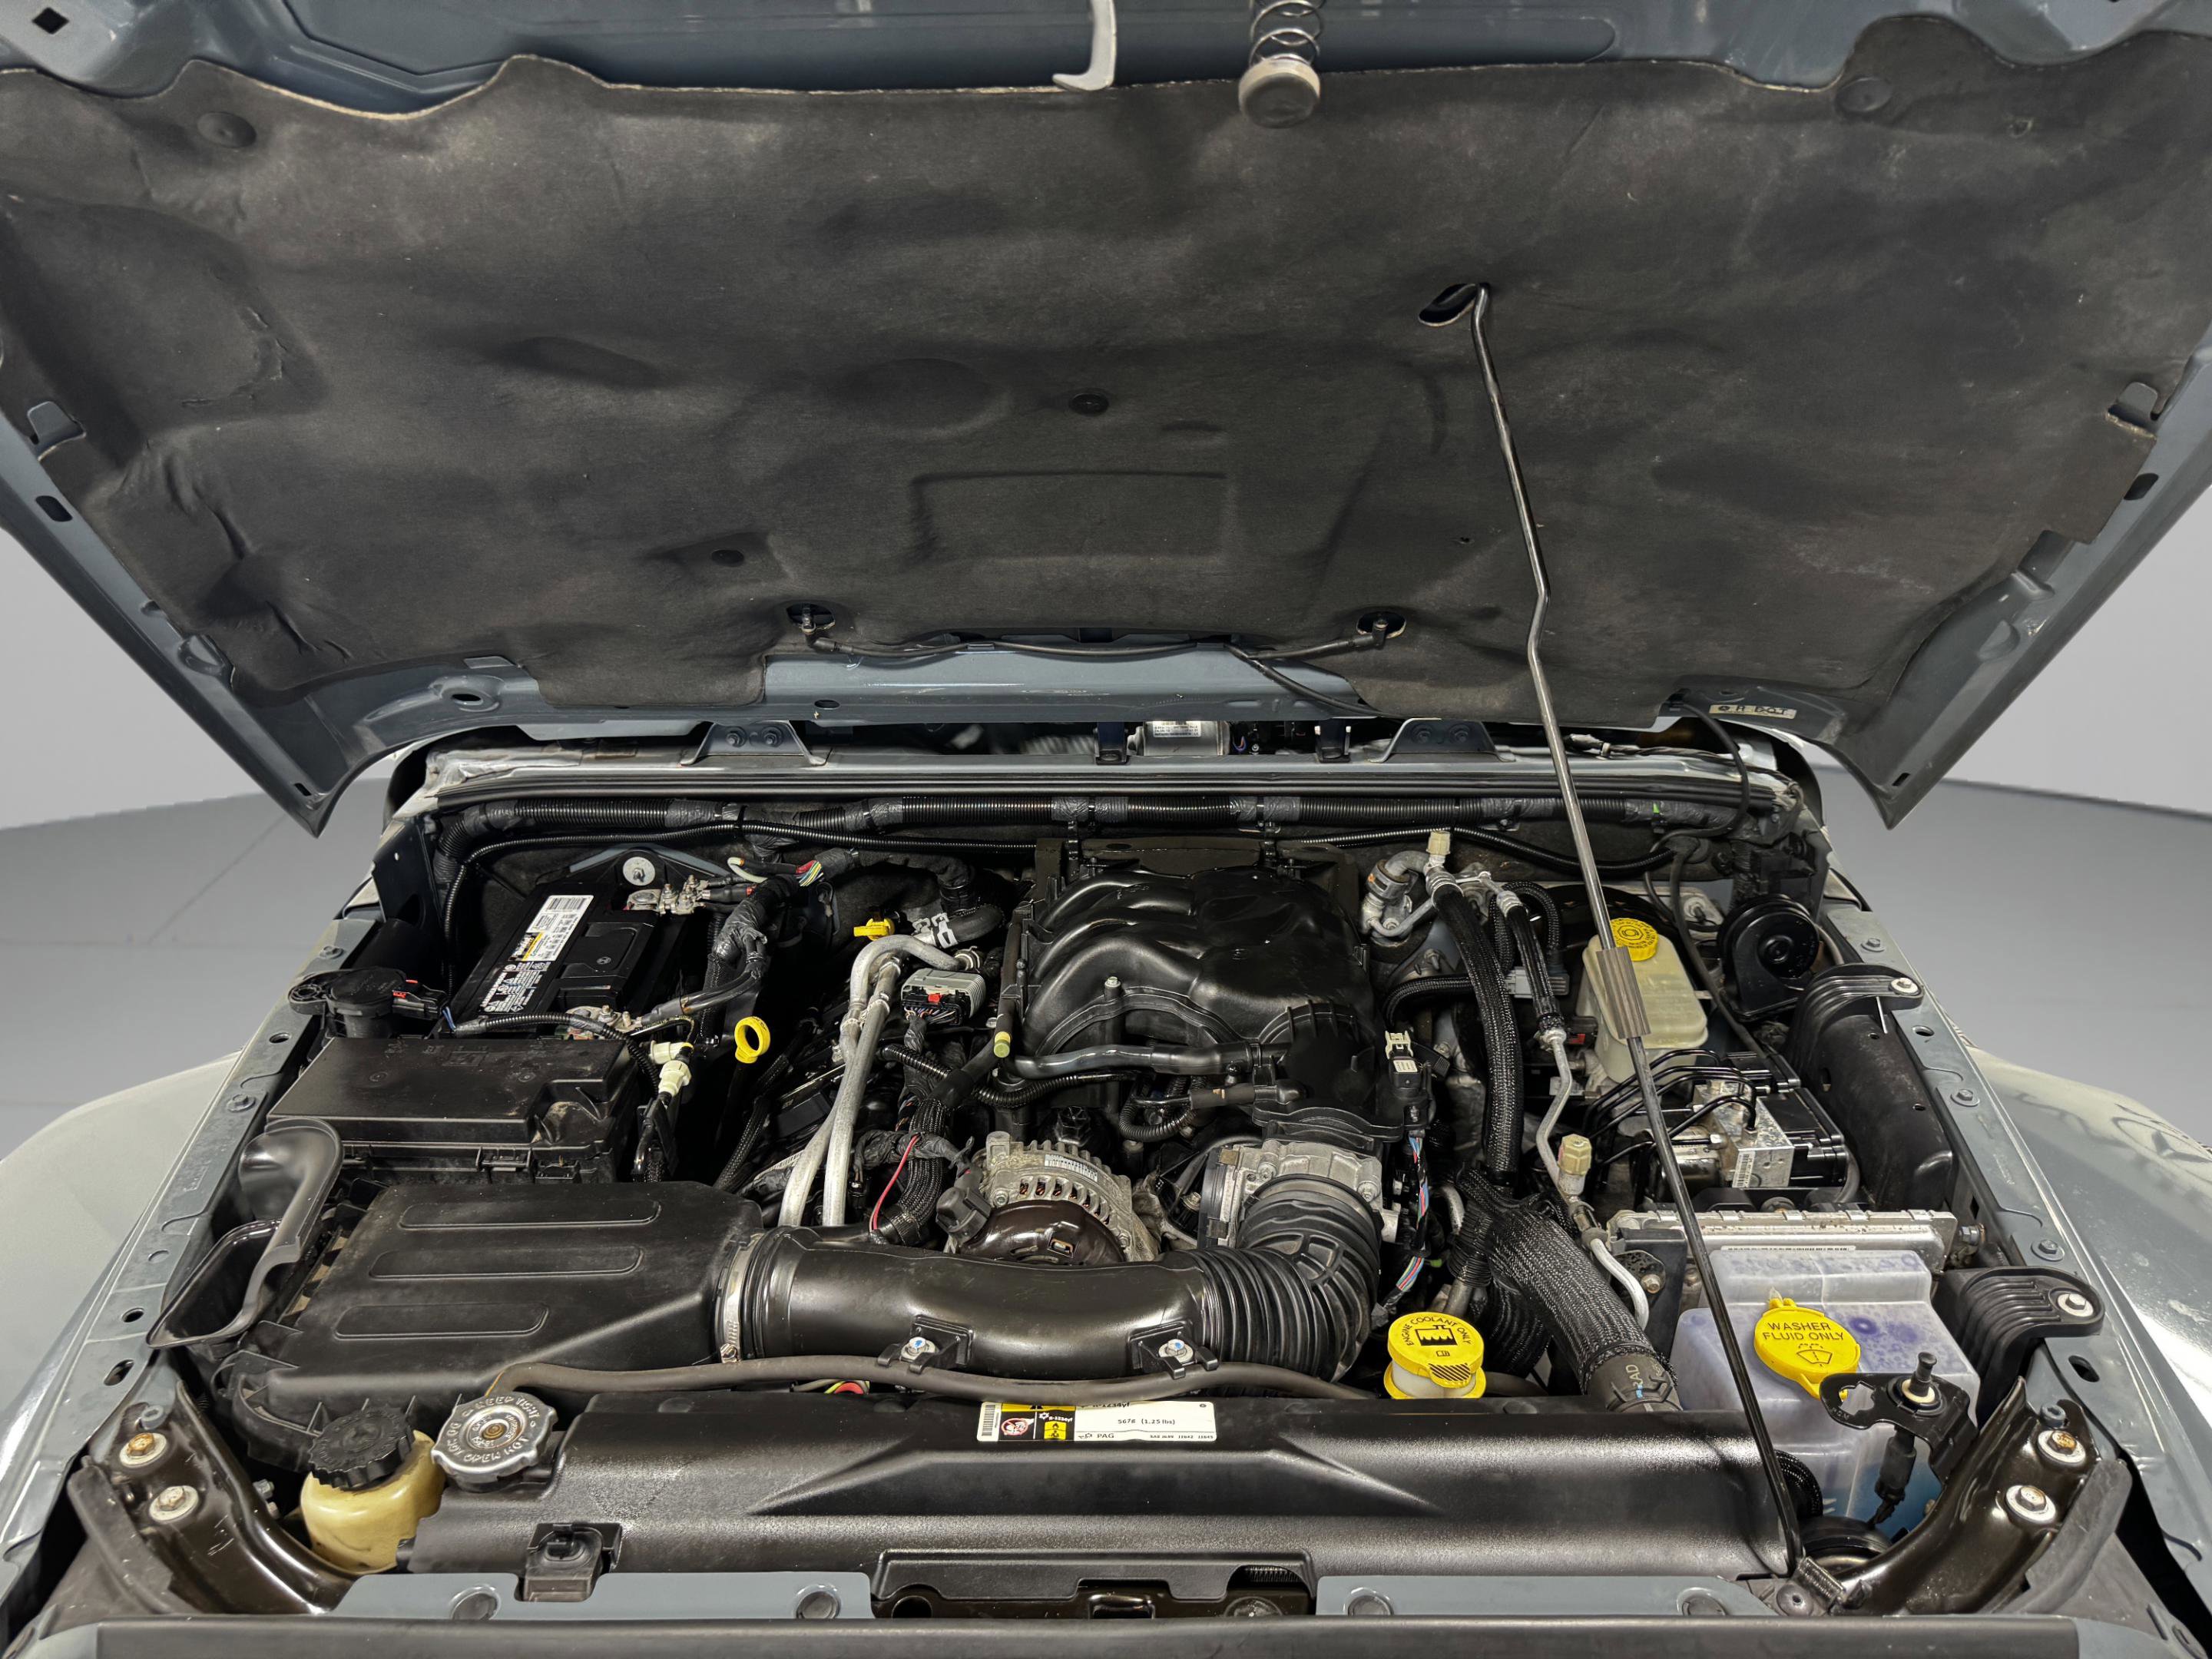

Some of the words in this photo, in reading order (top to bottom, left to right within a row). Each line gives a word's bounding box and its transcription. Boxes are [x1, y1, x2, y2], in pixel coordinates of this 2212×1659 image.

[1402, 1324, 1414, 1346] ENGINE
[1411, 1317, 1458, 1326] COOLANT
[1457, 1327, 1471, 1344] ONLY
[1763, 1332, 1804, 1340] FLUID
[1808, 1332, 1844, 1340] ONLY
[1767, 1322, 1831, 1330] WASHER
[475, 1396, 514, 1409] KEEP
[515, 1397, 540, 1418] TIGHT
[463, 1451, 502, 1462] OPEN
[504, 1437, 529, 1454] HOT
